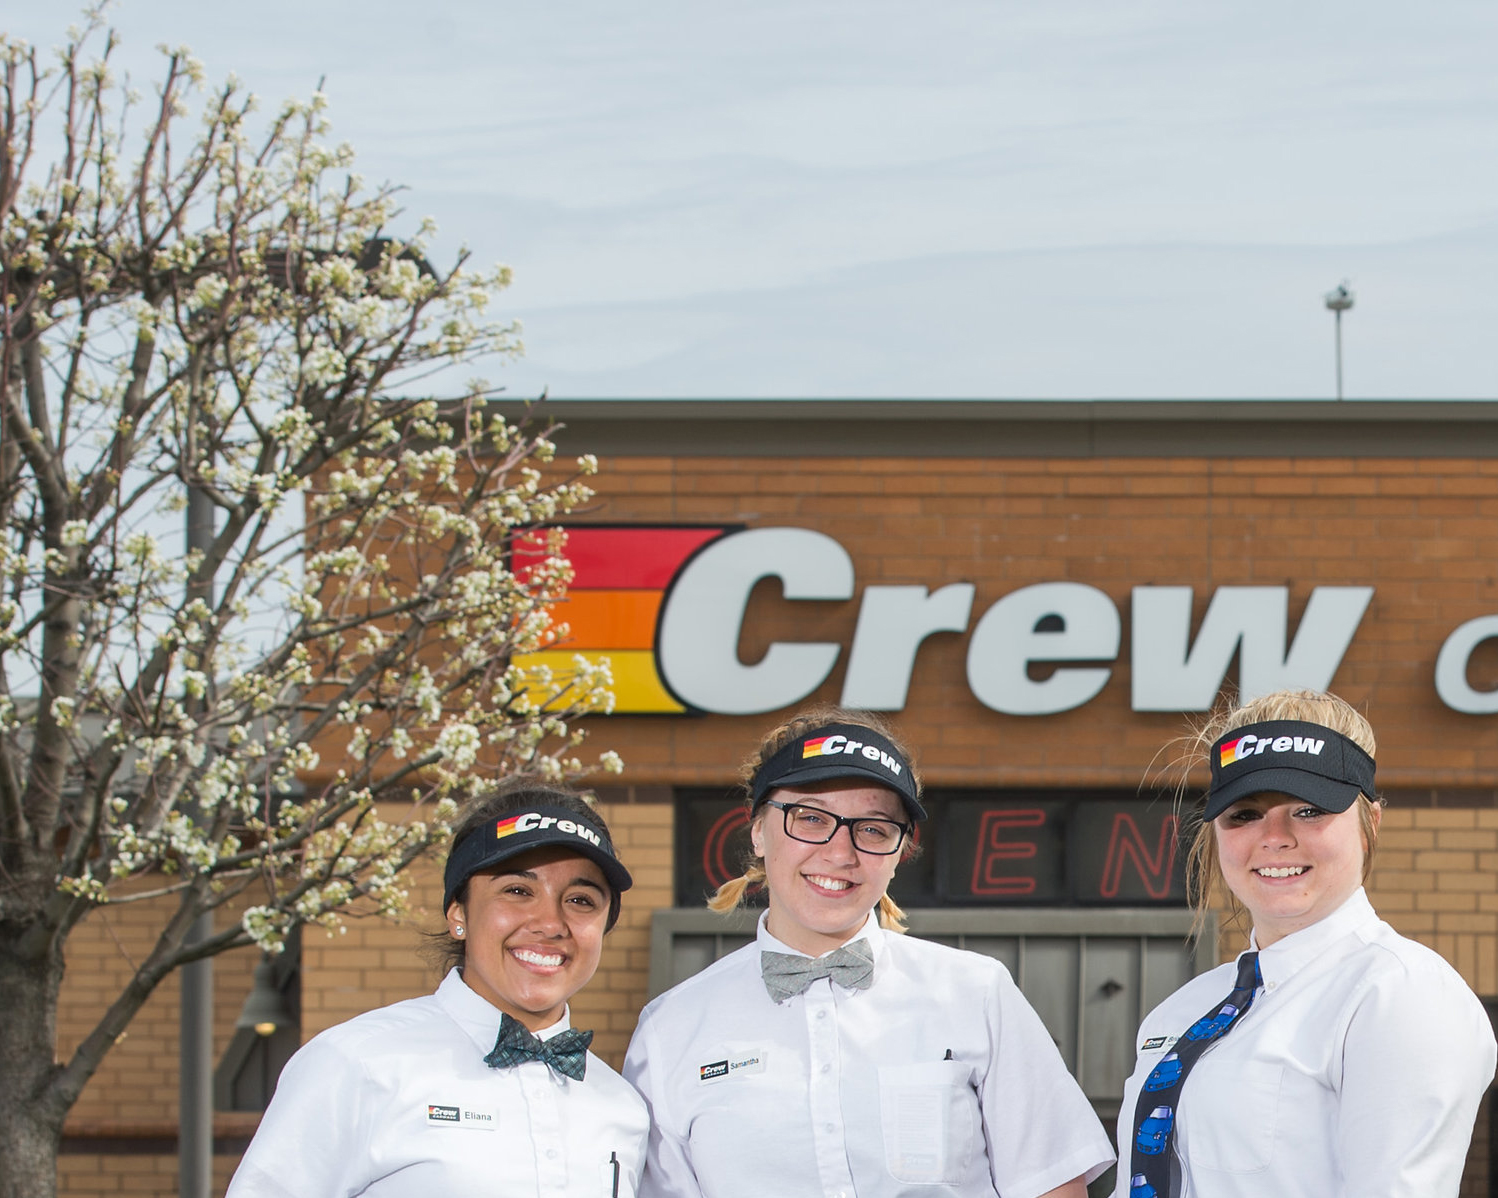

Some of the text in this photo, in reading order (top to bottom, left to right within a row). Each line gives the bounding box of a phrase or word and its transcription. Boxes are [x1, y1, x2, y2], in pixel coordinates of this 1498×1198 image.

[656, 526, 1374, 716] Crew
[820, 734, 902, 776] Crew
[1234, 734, 1326, 761] Crew
[514, 812, 601, 847] Crew
[705, 1064, 726, 1074] Crew
[432, 1107, 457, 1116] Crew
[464, 1111, 493, 1121] Eliana
